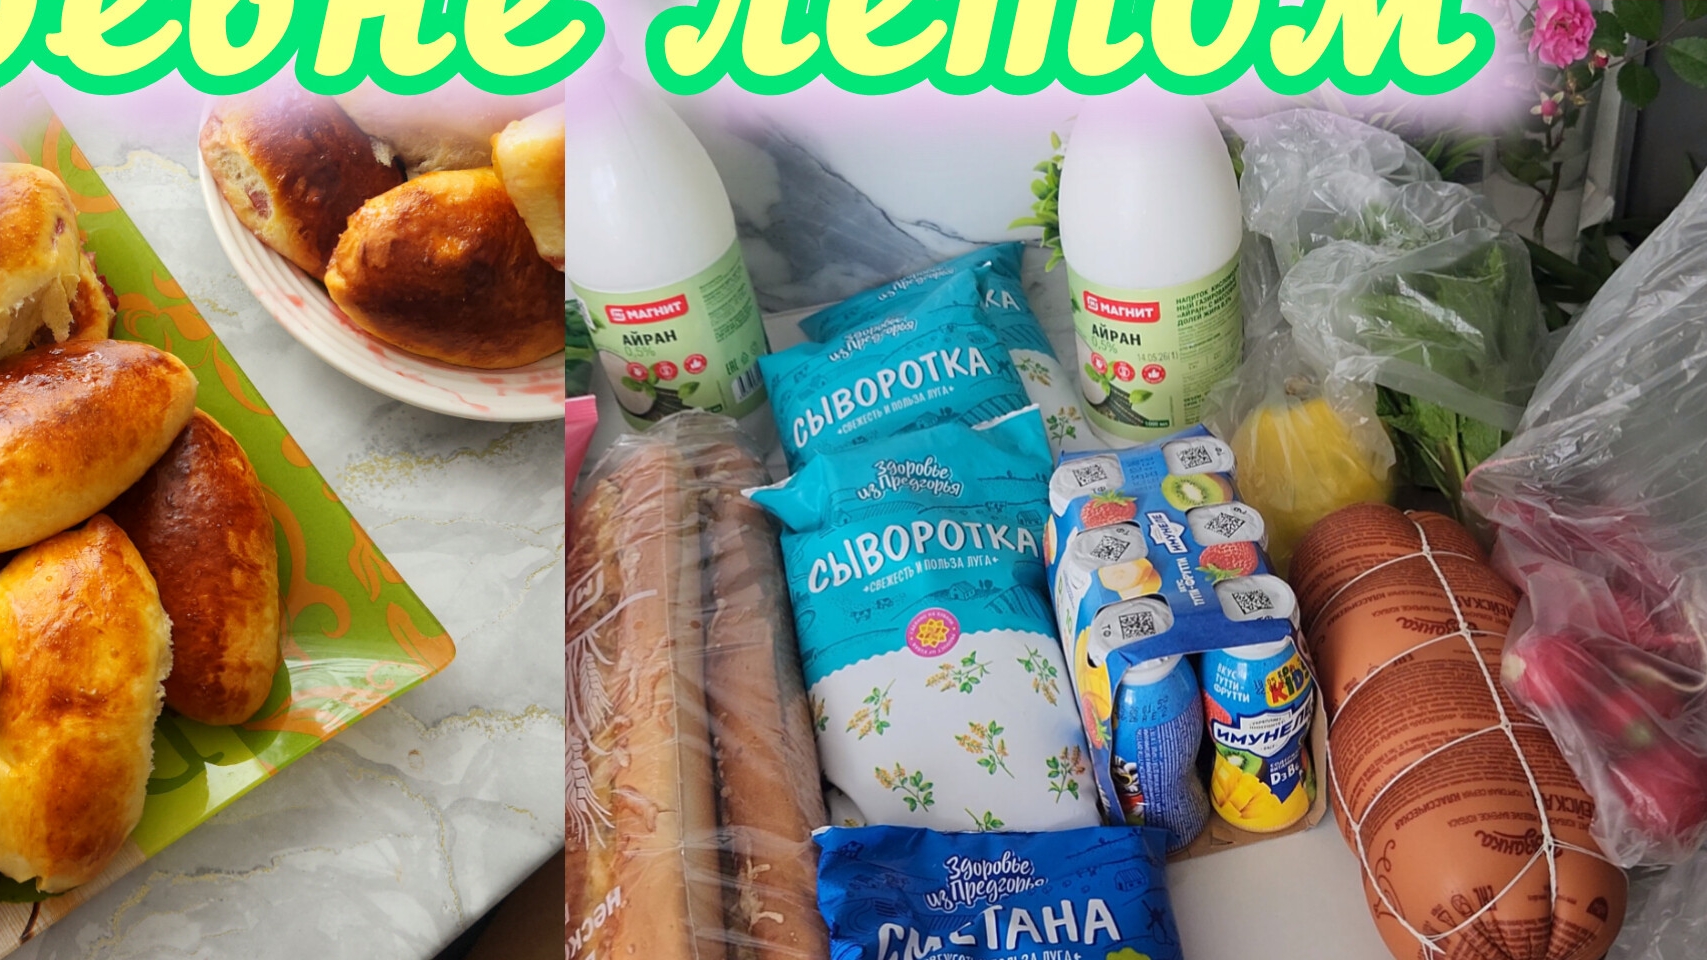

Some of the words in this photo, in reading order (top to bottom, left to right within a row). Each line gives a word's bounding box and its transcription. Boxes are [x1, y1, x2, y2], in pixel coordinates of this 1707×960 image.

[626, 301, 683, 321] МАГНИТ
[1100, 302, 1155, 319] МАГНИТ
[622, 330, 678, 346] АЙРАН
[1092, 323, 1142, 346] АЙРАН
[625, 346, 656, 357] 0,5%
[793, 346, 993, 448] СЫВОРОТКА
[892, 394, 927, 412] ПОЛЬЗА
[873, 455, 950, 480] Здоровье
[856, 482, 883, 501] из
[877, 472, 963, 497] Предгорья
[807, 519, 1039, 594] СЫВОРОТКА
[868, 567, 915, 592] СВЕЖЕСТЬ
[915, 560, 924, 572] И
[924, 555, 965, 572] ПОЛЬЗА
[966, 555, 993, 569] ЛУГА
[1327, 591, 1387, 628] КЛАССИЧЕСКАЯ
[1217, 662, 1238, 679] ВКУС
[1213, 682, 1251, 704] ФРУТТИ
[1462, 788, 1486, 799] СЕРИЯ
[1394, 792, 1462, 831] КЛАССИЧЕСКАЯ
[946, 849, 1032, 880] Здоровье
[925, 889, 953, 910] из
